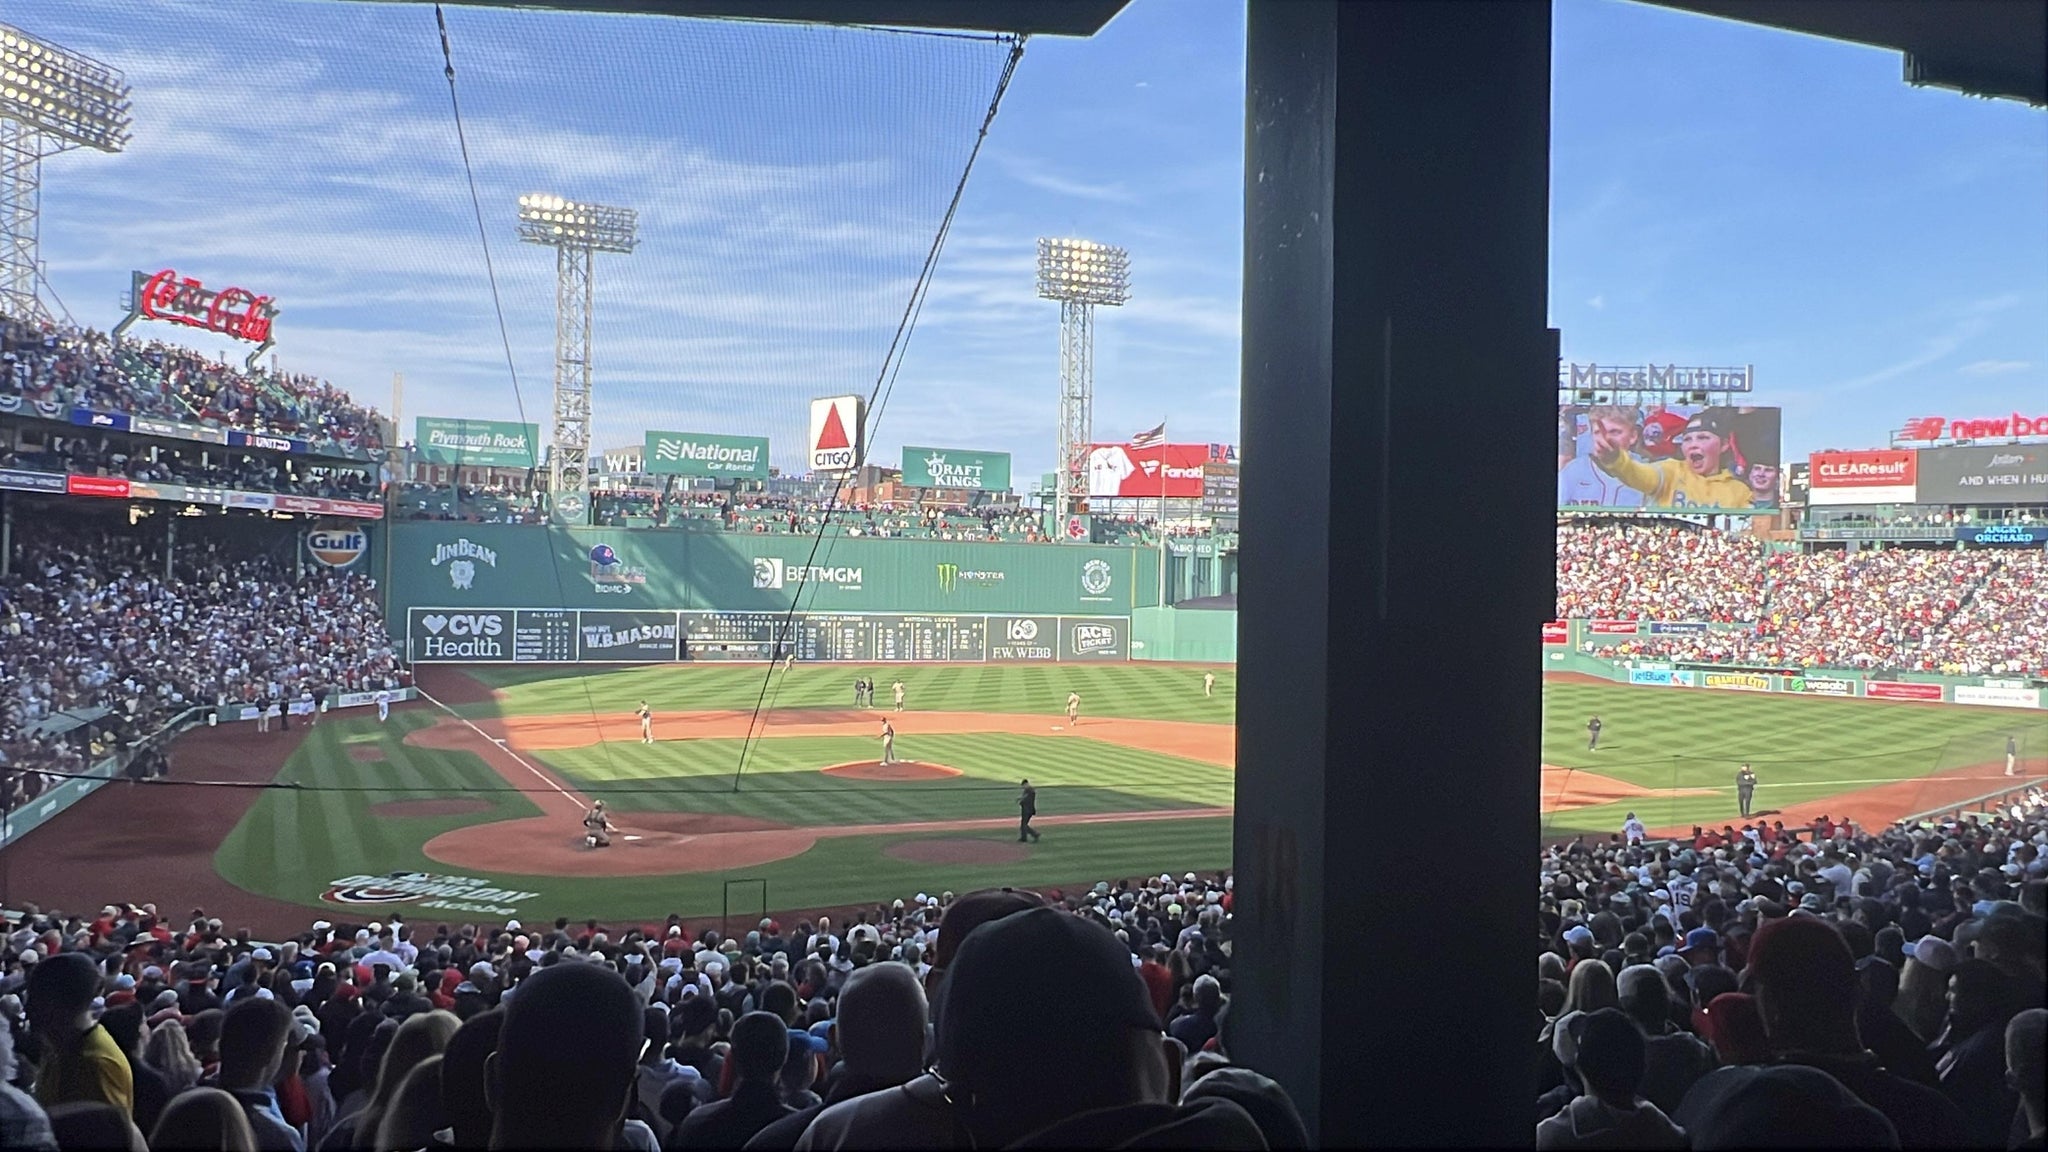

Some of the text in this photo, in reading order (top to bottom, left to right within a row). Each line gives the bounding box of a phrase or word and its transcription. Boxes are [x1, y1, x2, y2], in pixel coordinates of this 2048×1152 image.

[142, 269, 272, 341] Coca-Cola
[1570, 363, 1753, 391] MassMutual
[1950, 418, 2009, 438] new
[430, 430, 527, 448] Plymouth Rock
[680, 441, 758, 462] National
[815, 452, 851, 466] CITGO
[707, 462, 754, 472] Car Rental
[928, 463, 983, 477] DRAFT
[1819, 461, 1905, 476] CLEAResult
[934, 476, 982, 487] KINGS
[1959, 474, 2048, 486] AND WHEN I HU
[310, 533, 362, 549] Gulf
[1974, 534, 2033, 542] ORCHARD
[431, 538, 497, 568] JIM BEAM
[786, 566, 862, 582] BETMGM
[959, 571, 1004, 580] MONSTER
[448, 615, 503, 636] CVS
[1007, 620, 1038, 640] 160
[1081, 627, 1112, 638] ACE
[425, 637, 502, 656] Health
[1082, 638, 1112, 648] TICKET
[993, 647, 1051, 659] F.W. WEBB
[1634, 672, 1666, 682] jetBlue
[1706, 674, 1768, 688] GRANITE CITY
[1805, 681, 1847, 690] wasabi
[458, 888, 540, 902] DAY
[1675, 892, 1691, 906] 19
